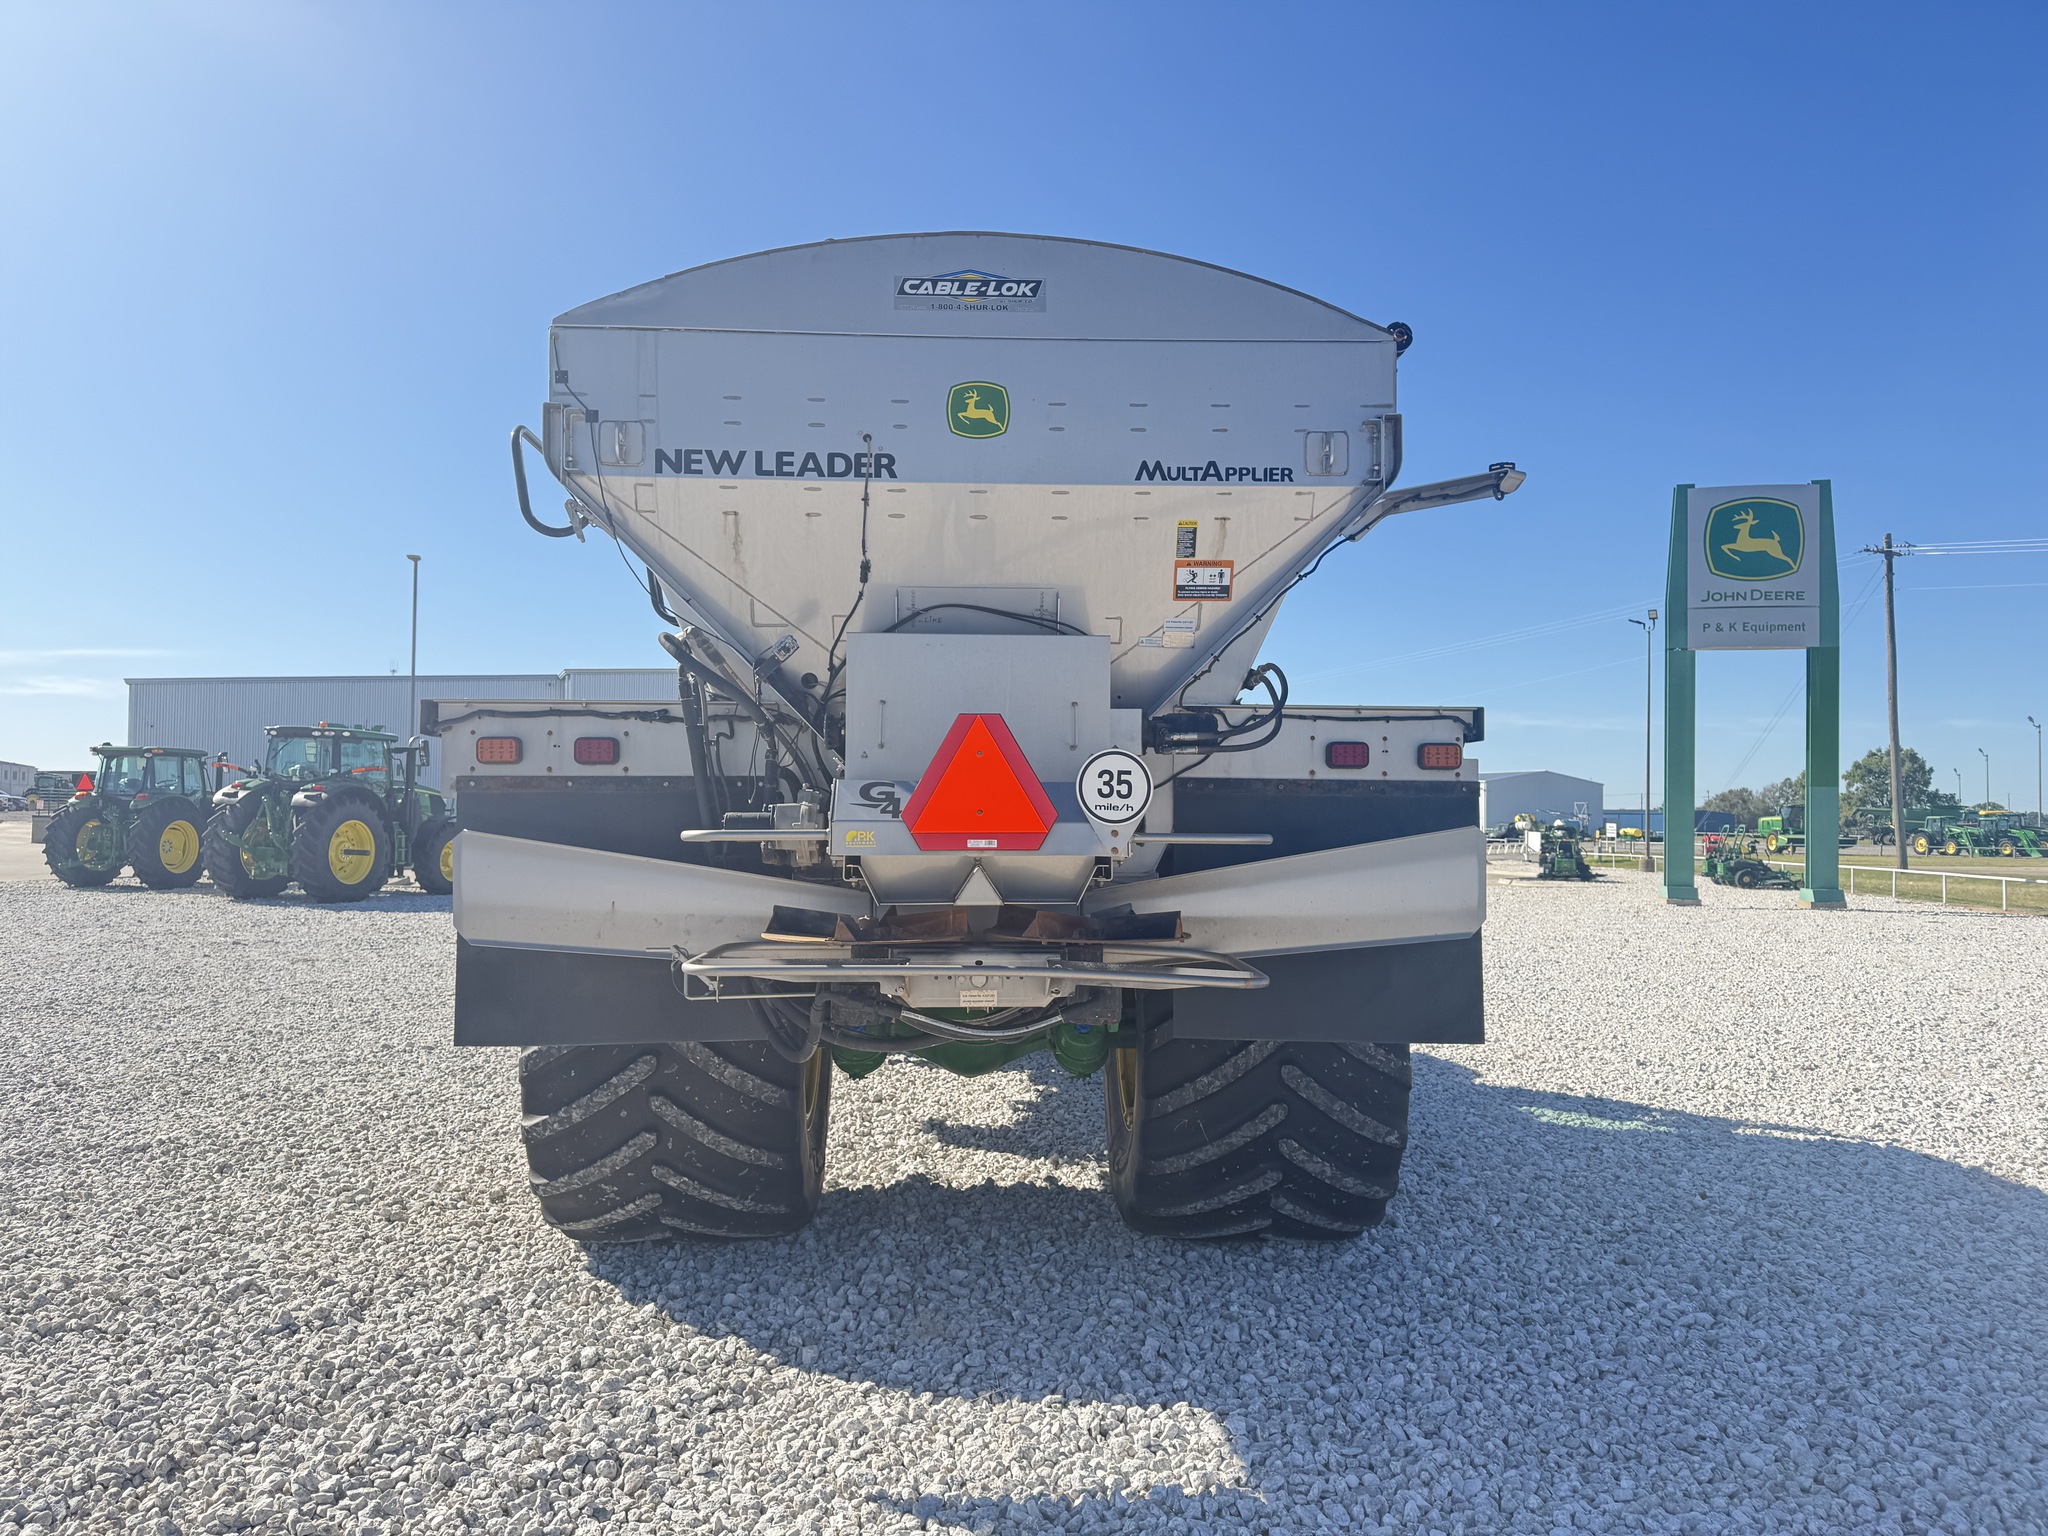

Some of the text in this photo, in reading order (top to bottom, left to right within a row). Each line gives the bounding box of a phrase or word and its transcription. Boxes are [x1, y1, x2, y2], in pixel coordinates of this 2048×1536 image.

[903, 280, 1037, 297] CABLE-LOK
[930, 303, 1009, 311] 1-800-4-SHUR-LOK
[654, 448, 898, 479] NEW LEADER
[1134, 459, 1294, 482] MULTAPPLIER
[1700, 589, 1806, 603] JOHN DEERE
[1702, 621, 1806, 634] P & K Equipment
[1097, 769, 1133, 799] 35
[858, 781, 902, 819] G4
[1094, 803, 1134, 812] mile/h
